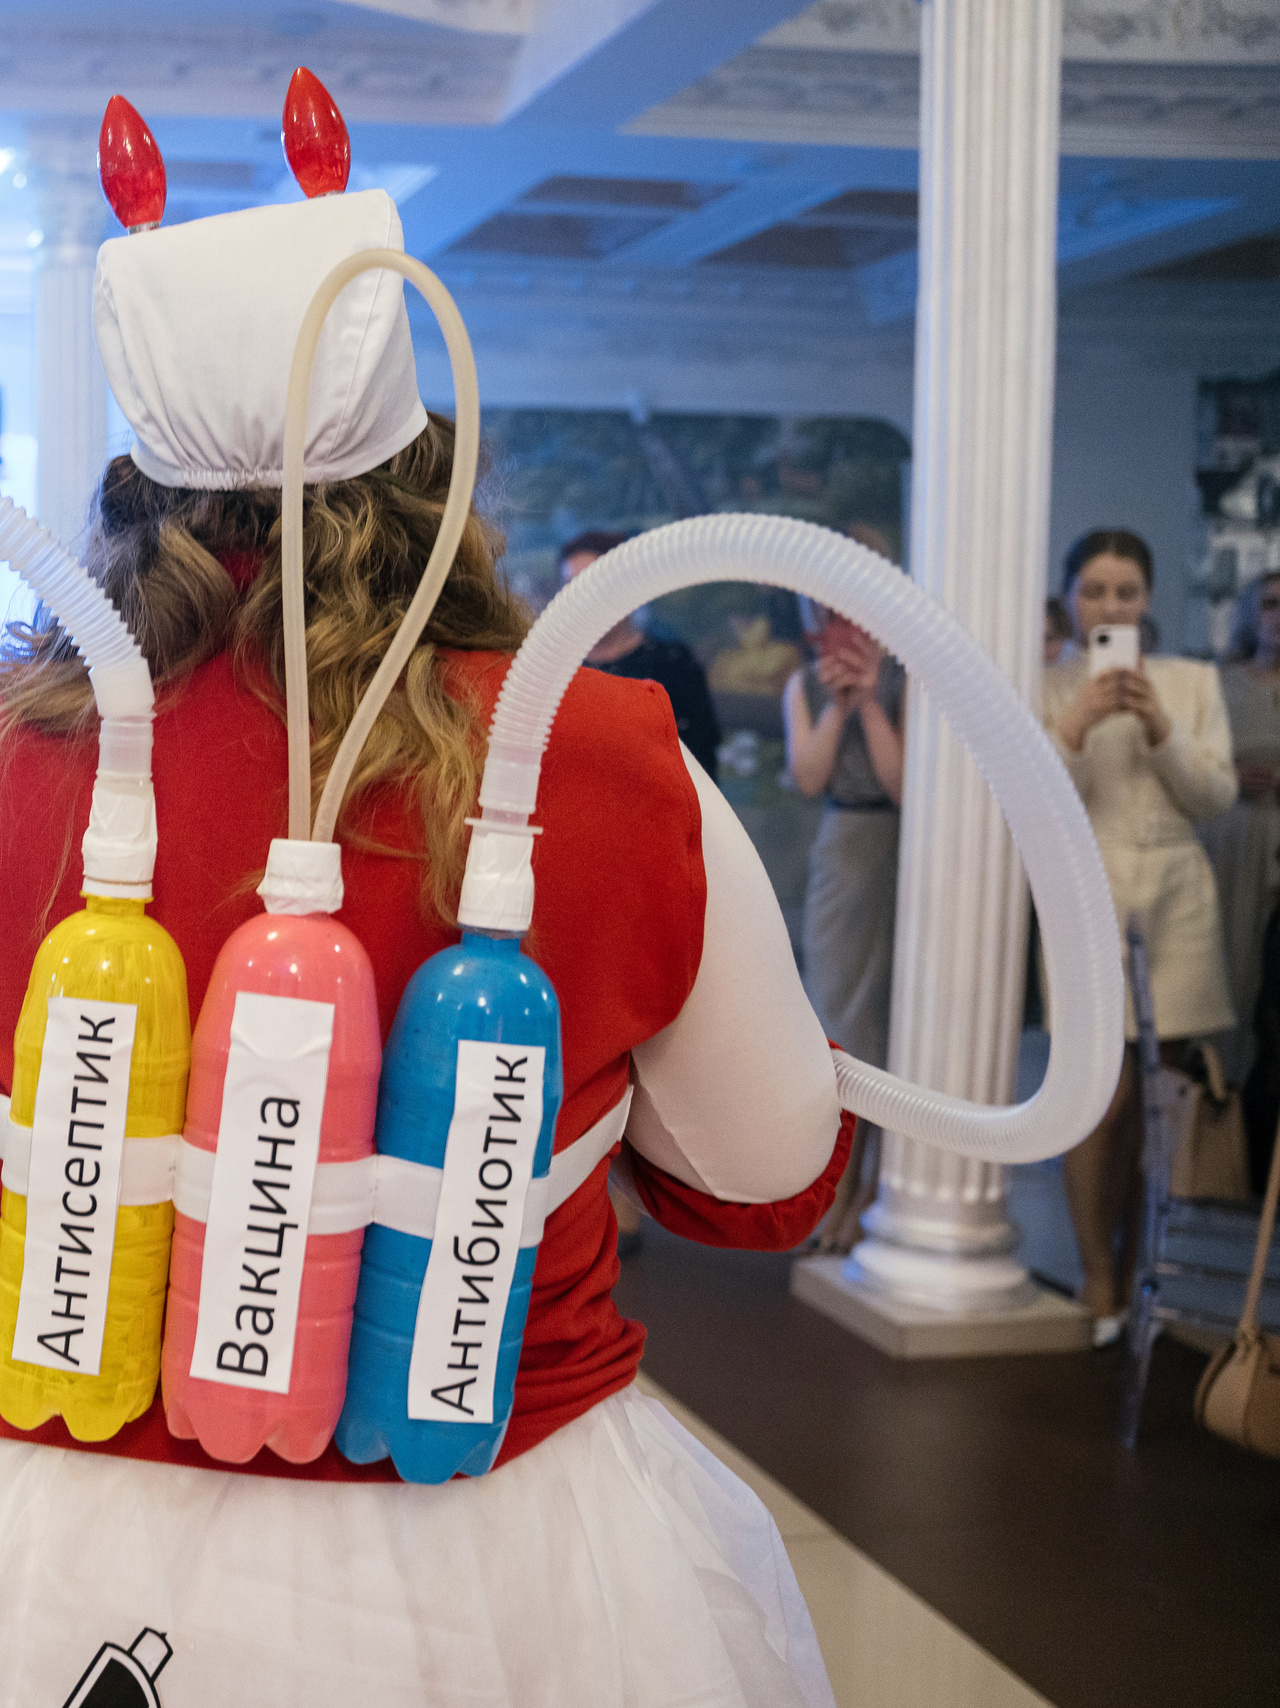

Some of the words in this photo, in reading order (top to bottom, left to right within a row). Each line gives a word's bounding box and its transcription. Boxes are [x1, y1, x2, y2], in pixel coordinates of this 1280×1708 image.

[37, 1013, 116, 1365] Антисептик
[216, 1096, 301, 1377] Вакцина
[431, 1055, 528, 1415] Антибиотик
